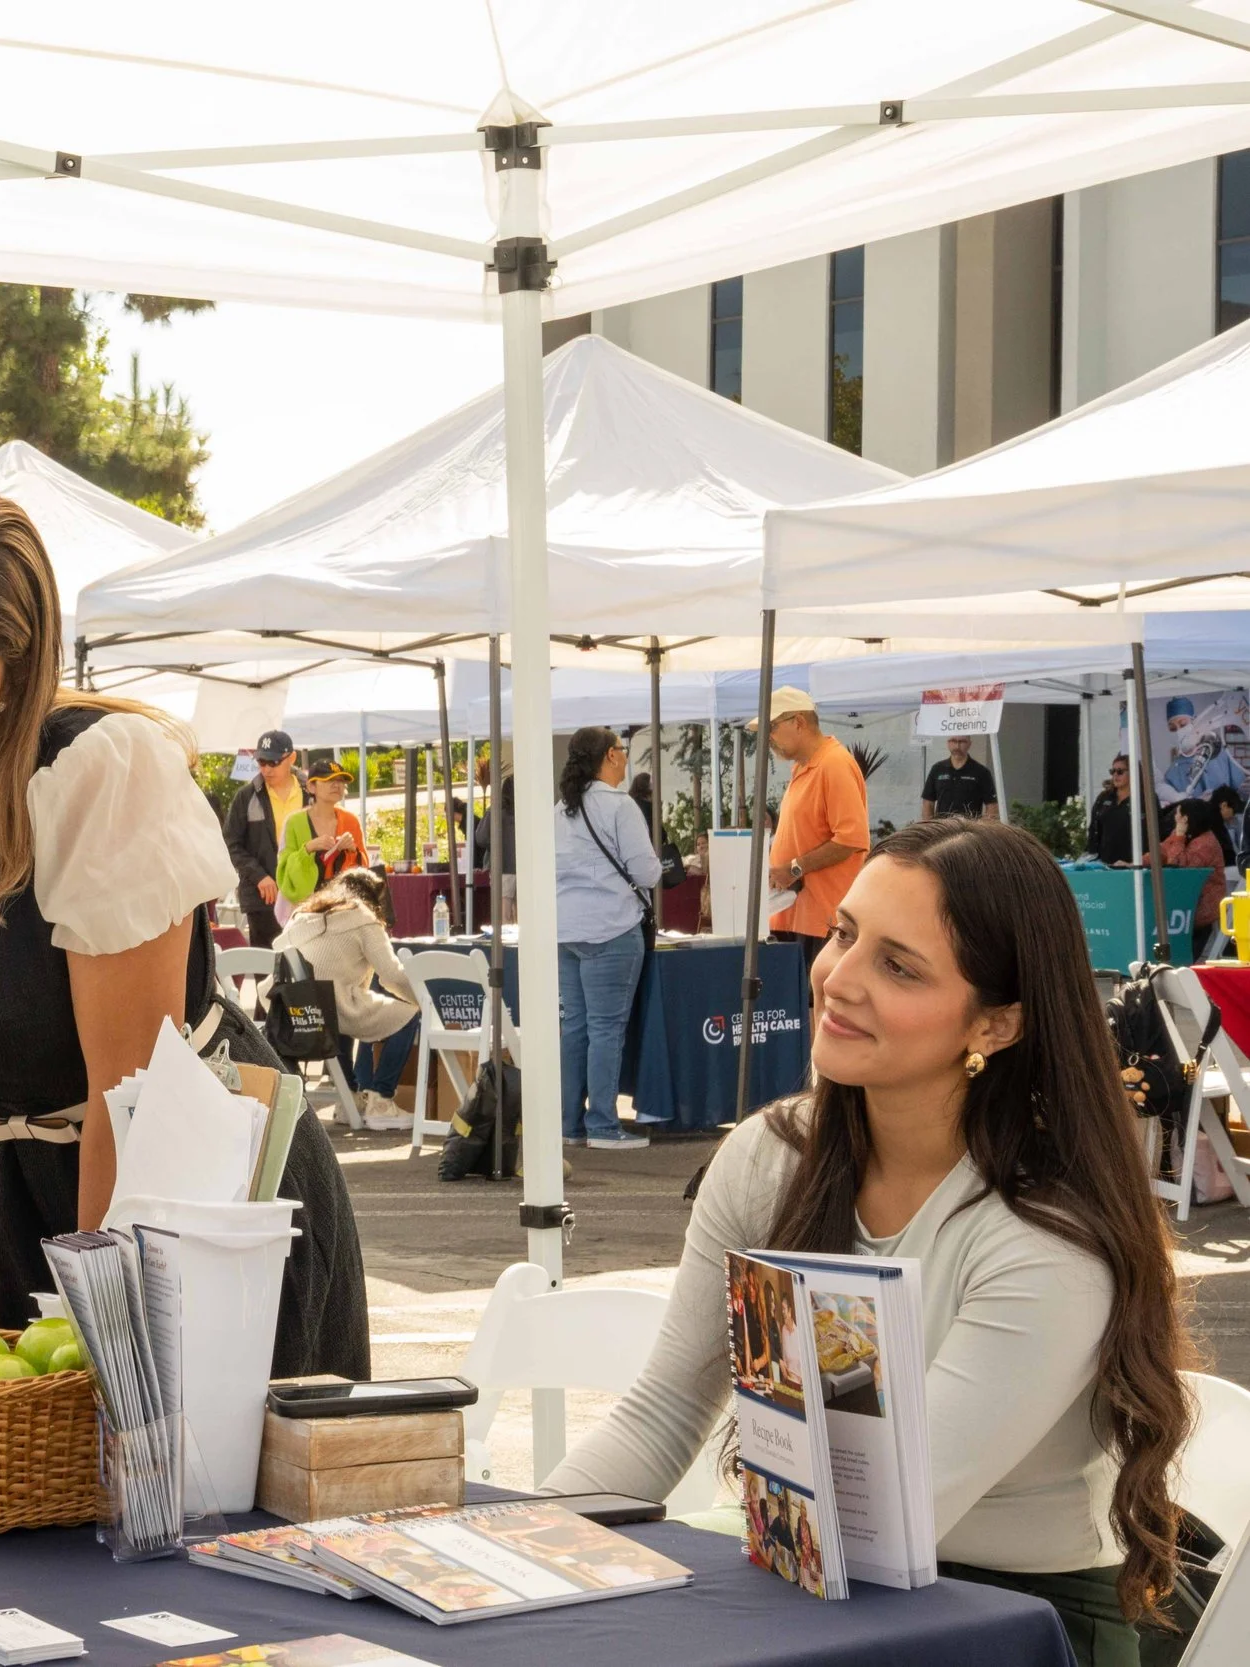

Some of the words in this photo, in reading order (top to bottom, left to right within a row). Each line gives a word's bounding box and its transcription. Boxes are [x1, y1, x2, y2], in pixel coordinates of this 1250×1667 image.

[949, 706, 981, 718] Dental
[940, 719, 988, 732] Screening
[439, 994, 475, 1007] CENTER
[441, 1007, 481, 1019] HEALTH
[731, 1011, 764, 1024] CEER
[766, 1009, 786, 1020] FOR
[732, 1021, 768, 1035] HELTH
[770, 1018, 801, 1031] CARE
[752, 1418, 775, 1447] Recipe
[774, 1427, 794, 1453] Book
